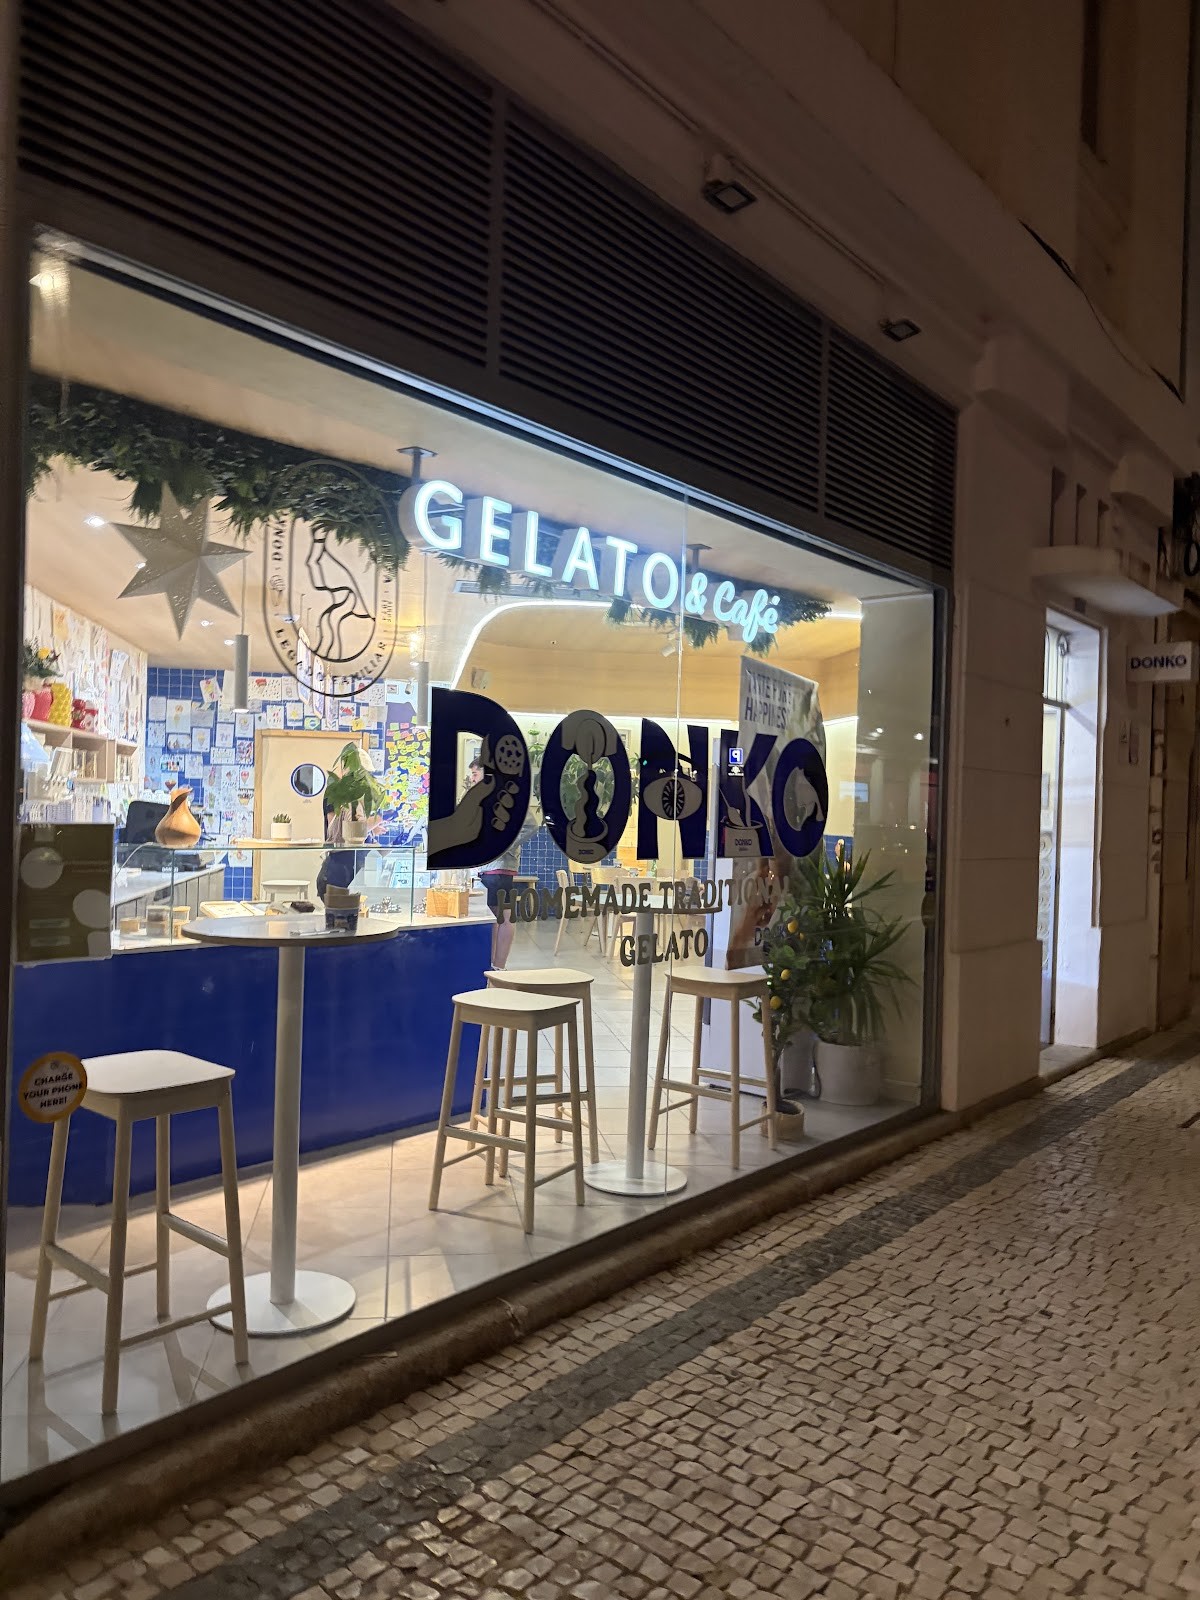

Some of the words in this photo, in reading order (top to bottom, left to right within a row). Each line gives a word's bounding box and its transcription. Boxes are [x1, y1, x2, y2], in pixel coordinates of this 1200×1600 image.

[413, 479, 679, 609] GELATO
[685, 572, 708, 615] &
[712, 580, 781, 643] Café
[1130, 655, 1187, 669] DONKO
[427, 687, 829, 870] DONKO
[496, 883, 652, 924] HOMEMADE
[620, 928, 709, 967] GELATO
[23, 1089, 49, 1100] YOUR
[52, 1081, 82, 1094] PHONE
[34, 1073, 73, 1087] CHARGE
[40, 1097, 67, 1108] HERE!
